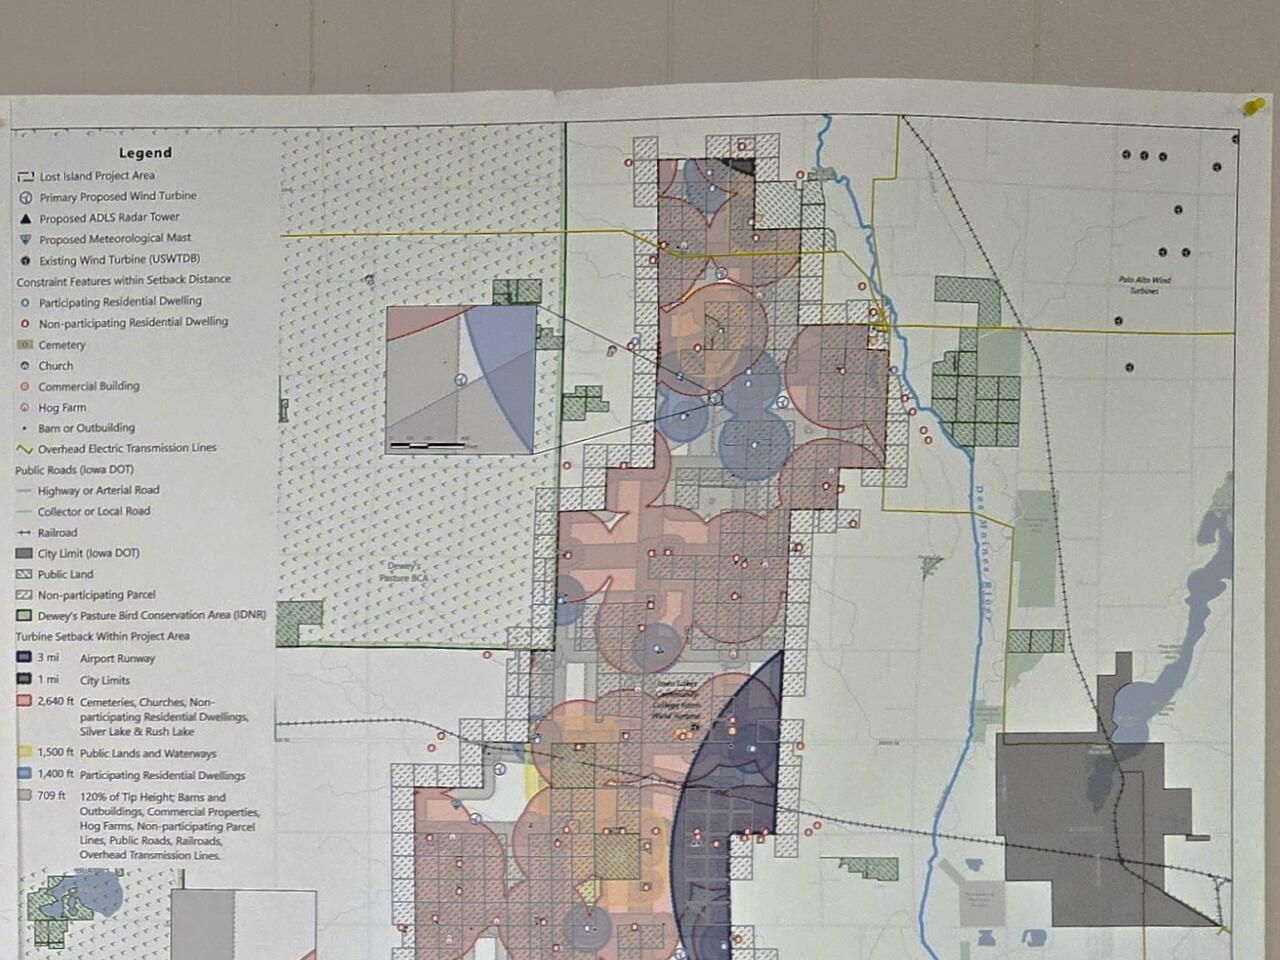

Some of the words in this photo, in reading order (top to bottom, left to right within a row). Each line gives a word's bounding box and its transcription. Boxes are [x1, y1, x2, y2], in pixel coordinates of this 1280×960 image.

[119, 147, 172, 161] Legend
[16, 277, 68, 287] Constraint
[70, 276, 112, 286] Features
[113, 275, 145, 285] within
[146, 274, 187, 285] Setback
[188, 274, 232, 284] Distance
[39, 297, 101, 310] Participating
[103, 296, 157, 307] Residential
[159, 295, 202, 308] Dwelling
[39, 317, 126, 331] Non-participating
[129, 317, 183, 327] Residential
[185, 316, 229, 329] Dwelling
[38, 340, 87, 352] Cemetery
[38, 361, 74, 371] Church
[38, 381, 97, 392] Commercial
[99, 380, 140, 393] Building
[38, 403, 60, 415] Hog
[62, 403, 87, 412] Farm
[38, 424, 61, 433] Barn
[62, 425, 75, 433] or
[76, 422, 136, 435] Outbuilding
[15, 465, 45, 475] Public
[47, 465, 78, 475] Roads
[79, 465, 107, 476] (Iowa
[109, 464, 135, 476] DOT)
[38, 528, 78, 537] Railroad
[38, 548, 58, 561] City
[59, 548, 84, 558] Limit
[86, 548, 113, 560] (Iowa
[115, 548, 140, 559] DOT)
[38, 570, 68, 579] Public
[70, 569, 94, 579] Land
[38, 590, 124, 602] Non-participating
[127, 590, 156, 599] Parcel
[38, 611, 78, 623] Dewey's
[80, 611, 117, 620] Pasture
[118, 610, 139, 620] Bird
[140, 610, 205, 620] Conservation
[207, 610, 231, 619] Area
[233, 610, 267, 621] (IDNR)
[37, 653, 44, 662] 3
[46, 652, 60, 661] mi
[79, 654, 115, 665] Airport
[117, 654, 156, 665] Runway
[38, 675, 43, 684] 1
[46, 674, 59, 684] mi
[80, 675, 100, 687] City
[101, 675, 131, 685] Limits
[37, 748, 64, 758] 1,500
[66, 747, 75, 757] ft
[80, 749, 110, 758] Public
[111, 748, 141, 758] Lands
[142, 749, 162, 758] and
[164, 749, 218, 761] Waterways
